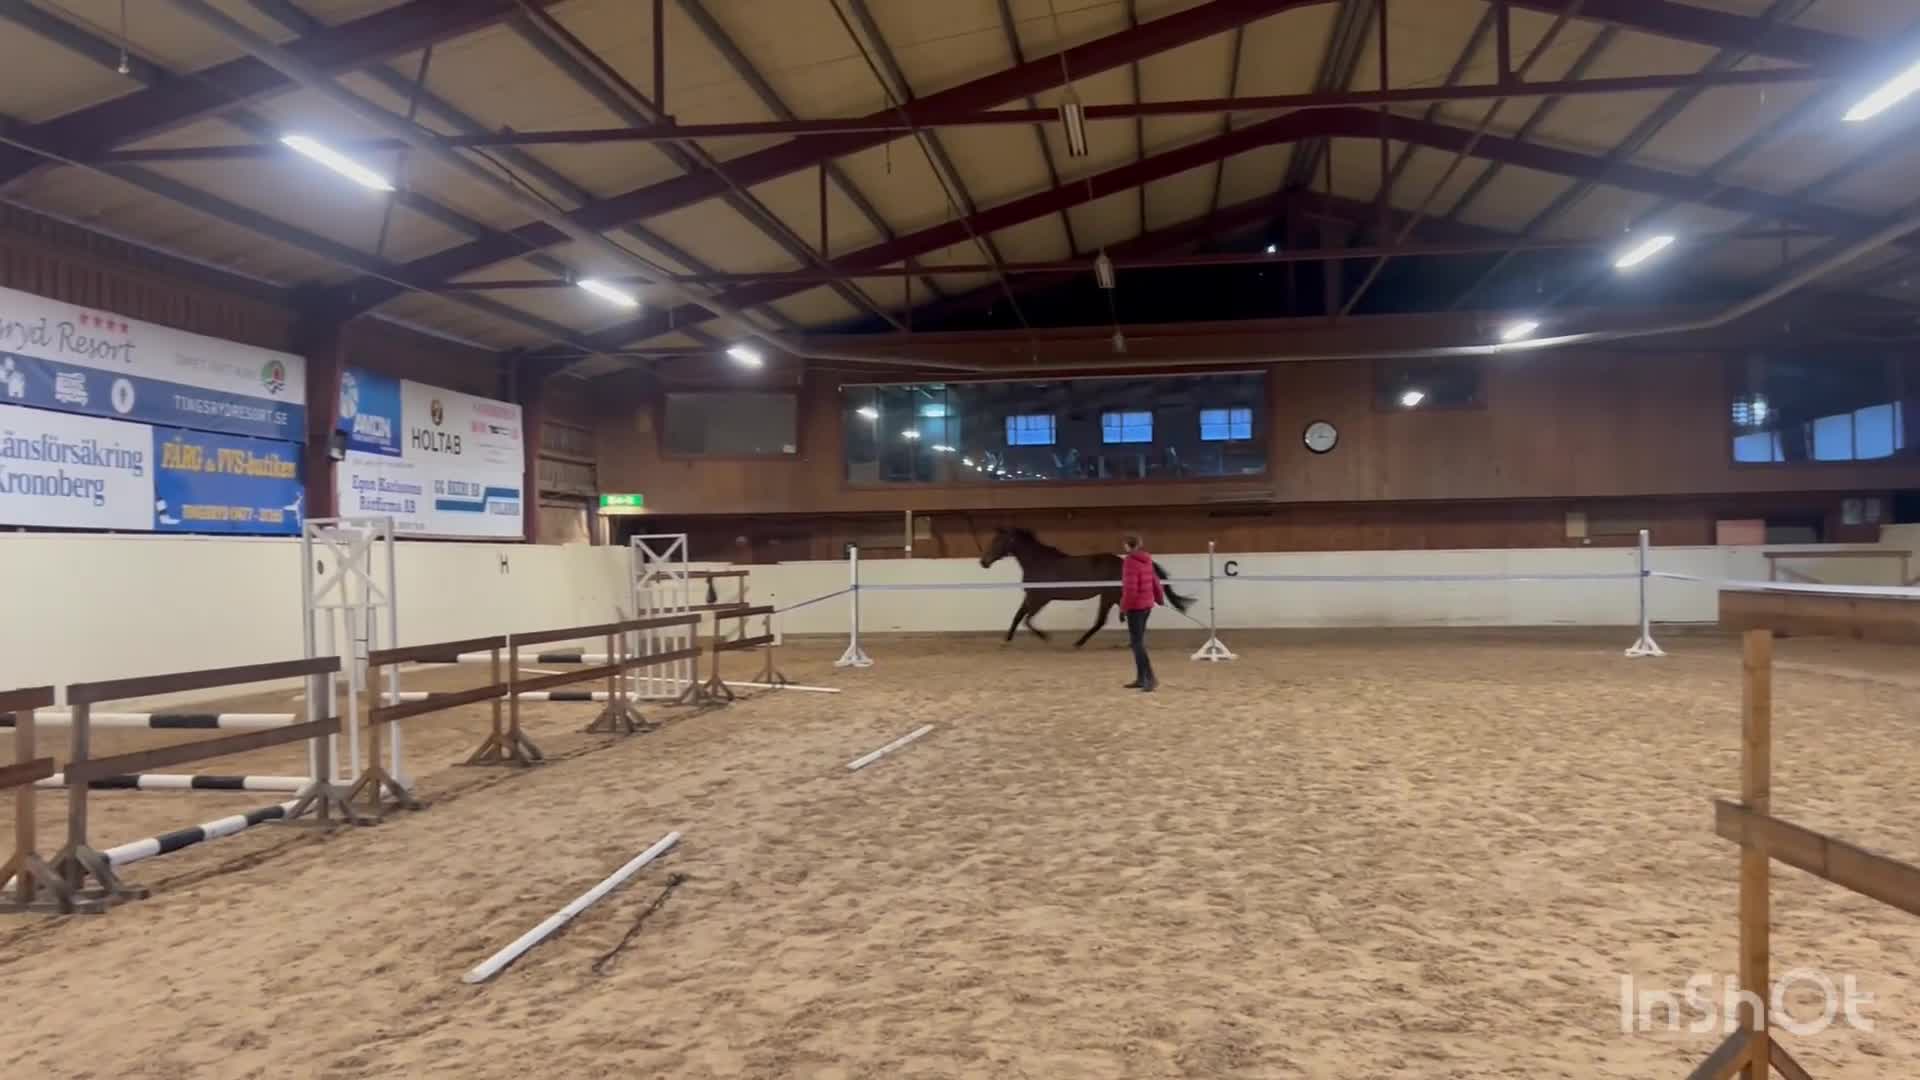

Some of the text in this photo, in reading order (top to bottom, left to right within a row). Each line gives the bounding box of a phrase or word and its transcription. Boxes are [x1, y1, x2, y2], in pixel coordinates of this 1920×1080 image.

[56, 320, 136, 363] Resort
[411, 427, 461, 455] HOLTAB
[1224, 560, 1239, 577] C
